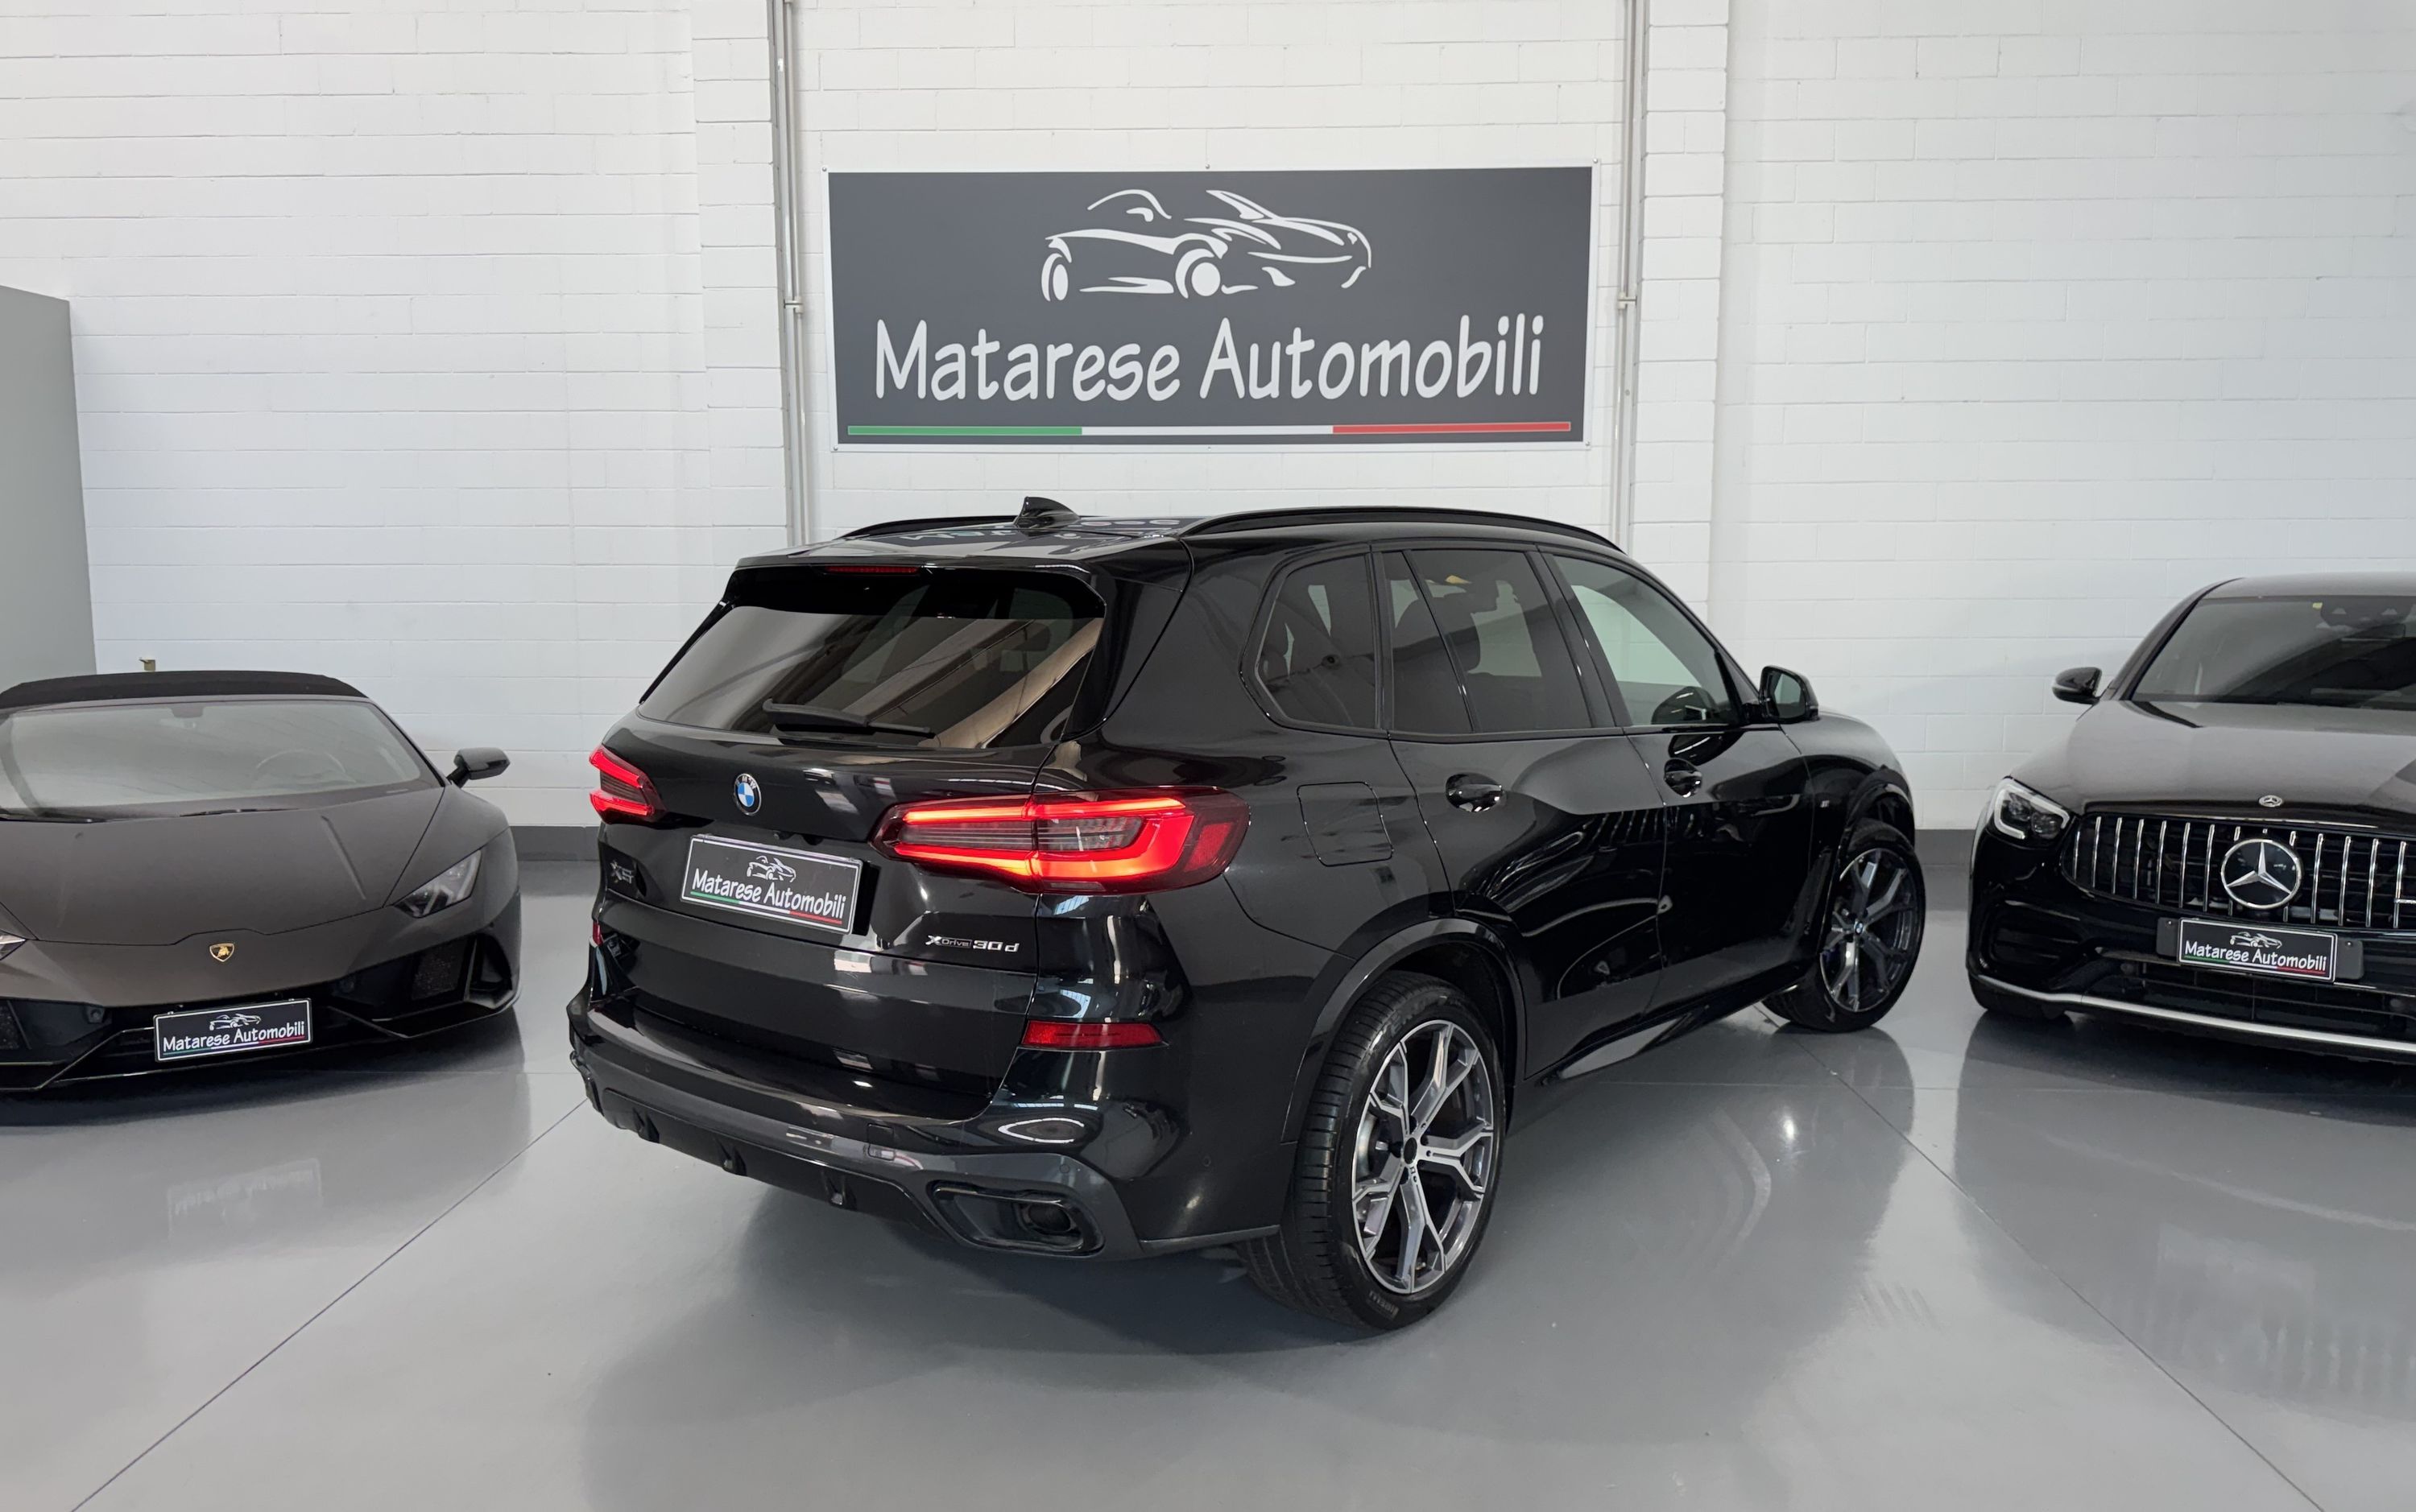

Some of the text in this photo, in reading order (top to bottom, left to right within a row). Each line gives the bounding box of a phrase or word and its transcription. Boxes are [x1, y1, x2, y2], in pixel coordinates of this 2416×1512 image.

[875, 313, 1544, 401] Matarese Automobili
[692, 868, 846, 918] Matarese Automobili
[2185, 940, 2327, 971] Matarese Automobili
[163, 1021, 304, 1051] Matarese Automobili
